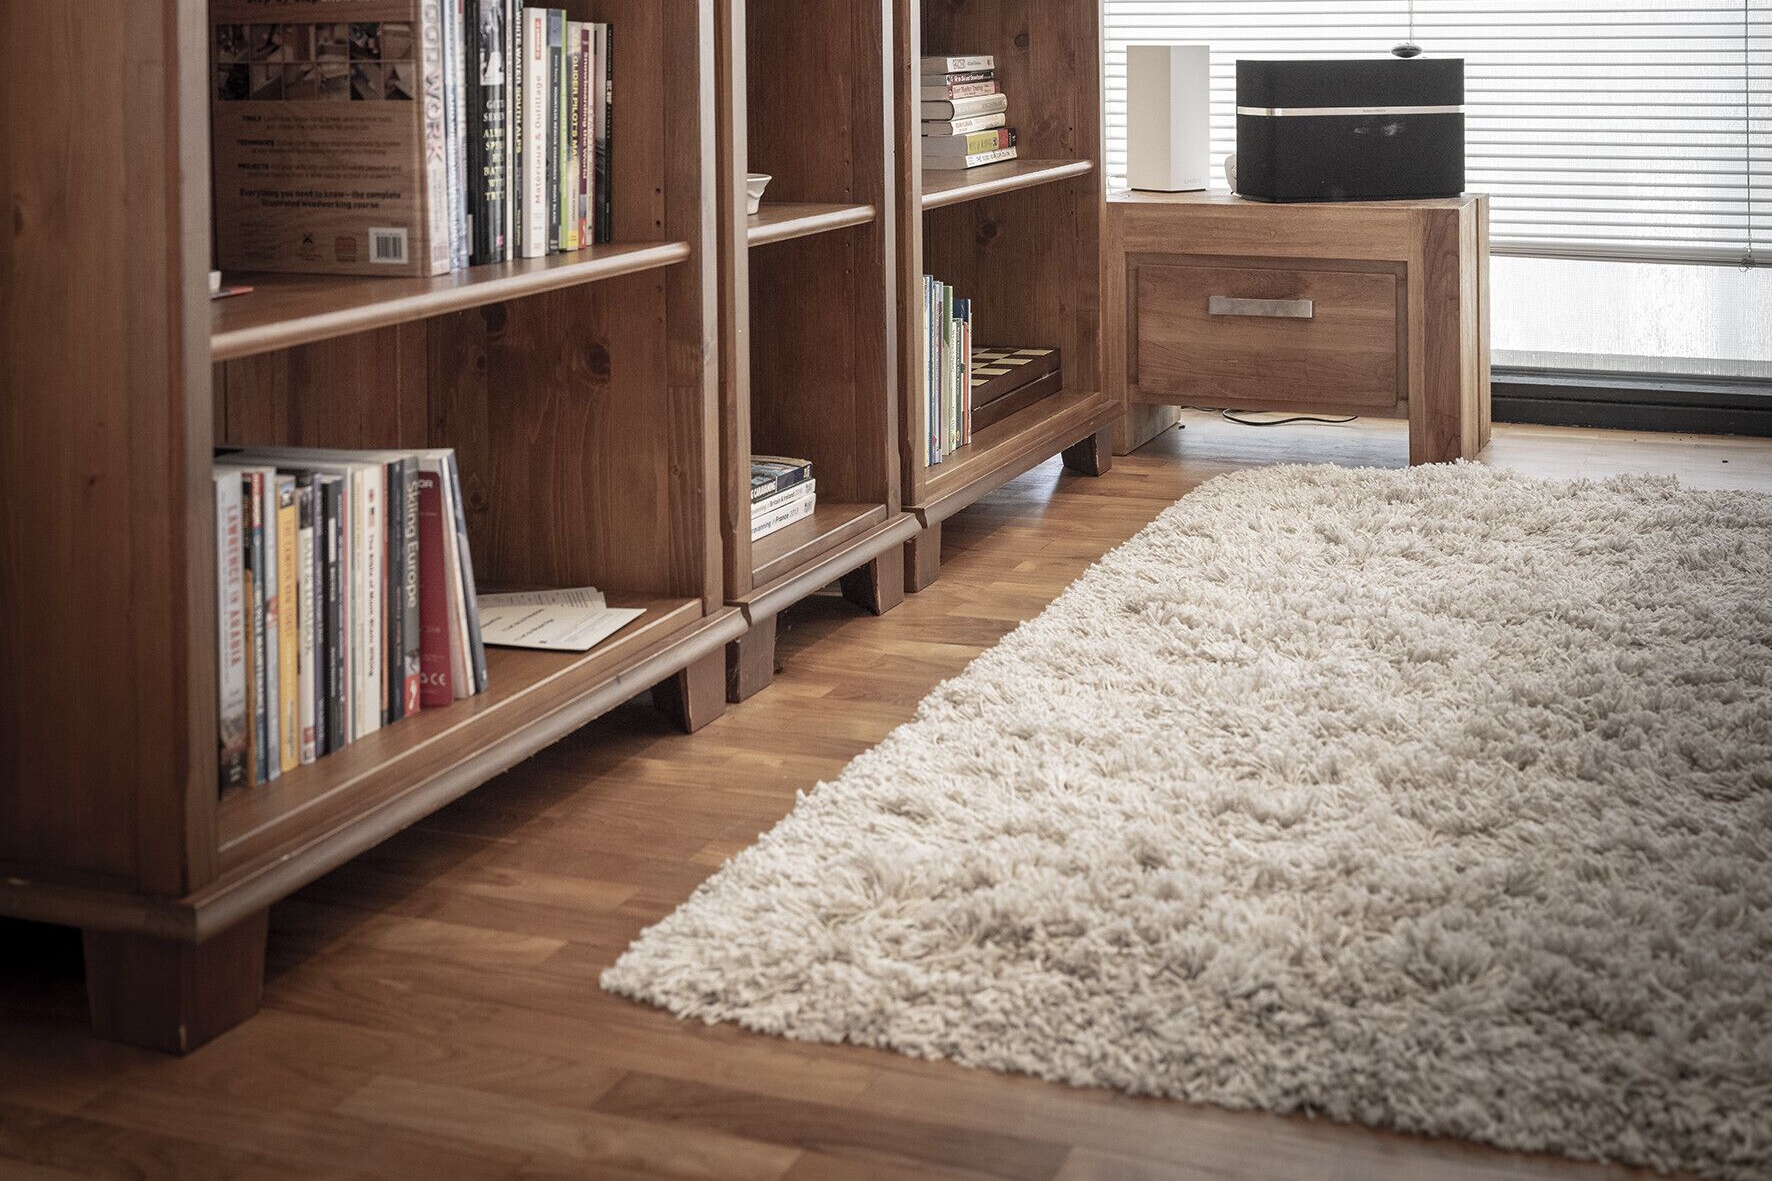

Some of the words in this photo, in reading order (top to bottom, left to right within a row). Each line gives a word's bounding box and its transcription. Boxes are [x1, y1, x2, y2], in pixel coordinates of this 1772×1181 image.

[534, 75, 543, 129] Outillage
[240, 189, 283, 198] Everything
[366, 191, 401, 200] complete
[534, 145, 543, 204] Matériaux
[302, 201, 351, 209] woodworking
[404, 480, 419, 538] Skiing
[776, 513, 789, 522] France
[227, 503, 240, 585] LAWRENCE
[405, 540, 419, 608] Europe
[231, 609, 242, 667] ARABIA
